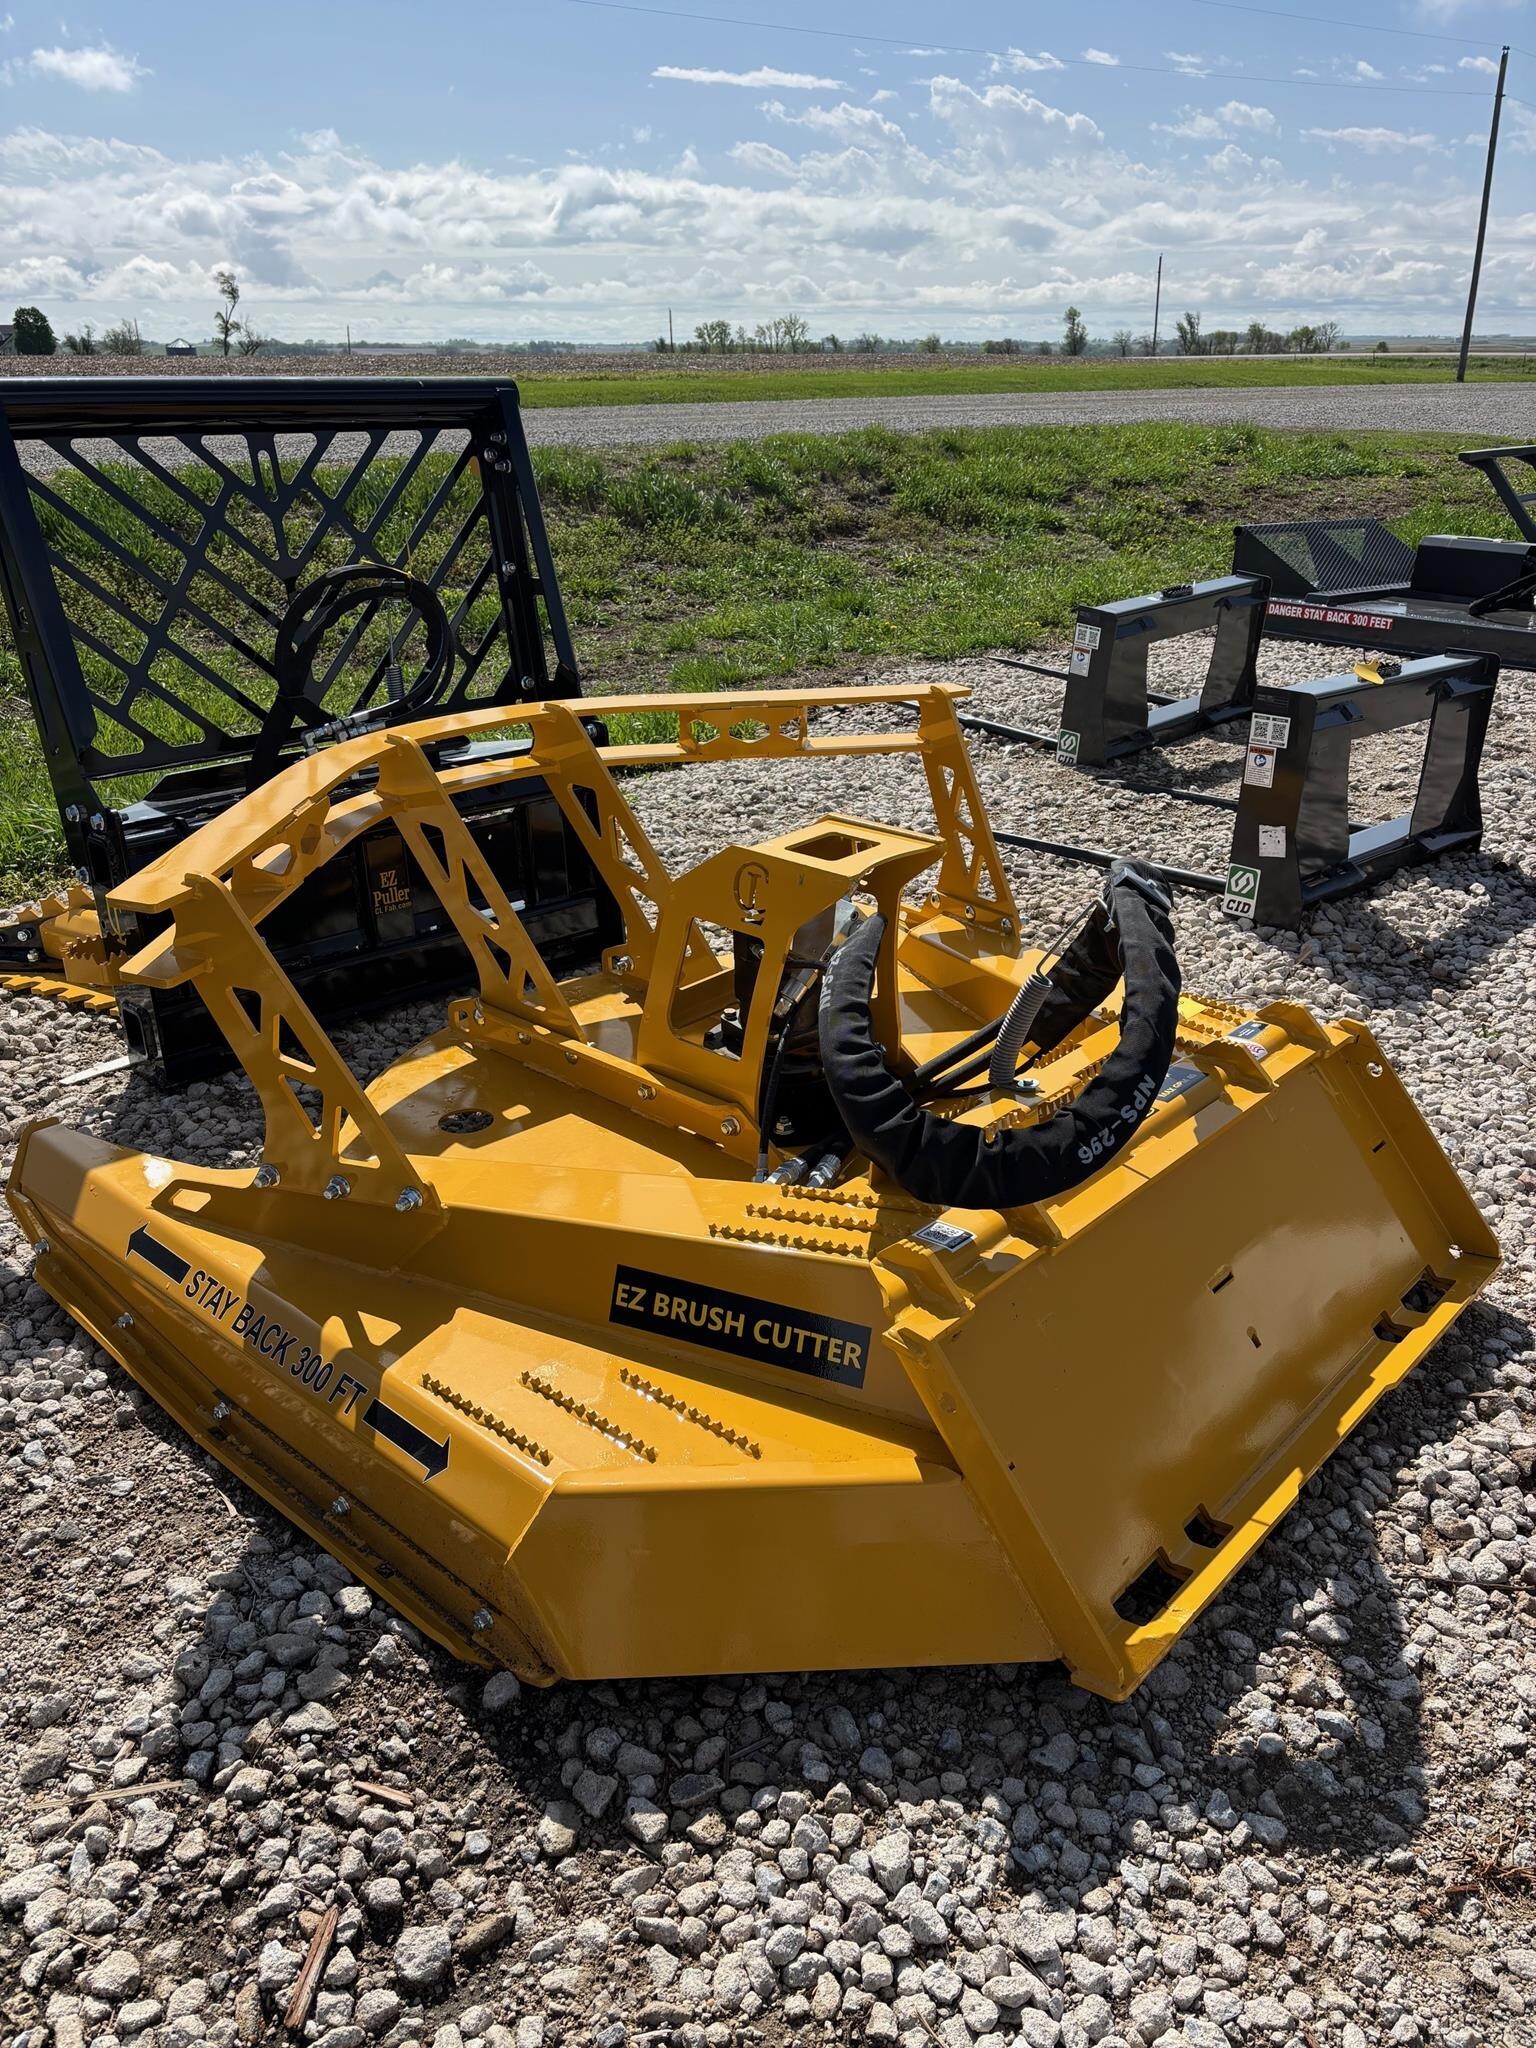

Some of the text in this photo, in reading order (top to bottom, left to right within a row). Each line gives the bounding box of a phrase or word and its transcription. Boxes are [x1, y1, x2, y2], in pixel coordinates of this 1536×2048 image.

[1268, 603, 1393, 630] DANGER STAY BACK 300 FEET
[379, 870, 398, 888] EZ
[372, 886, 410, 907] Puller
[1226, 899, 1252, 914] CID
[1077, 1073, 1157, 1165] NPS-296
[615, 1283, 863, 1370] EZ BRUSH CUTTER
[185, 1269, 369, 1416] STAY BACK 300 FT
